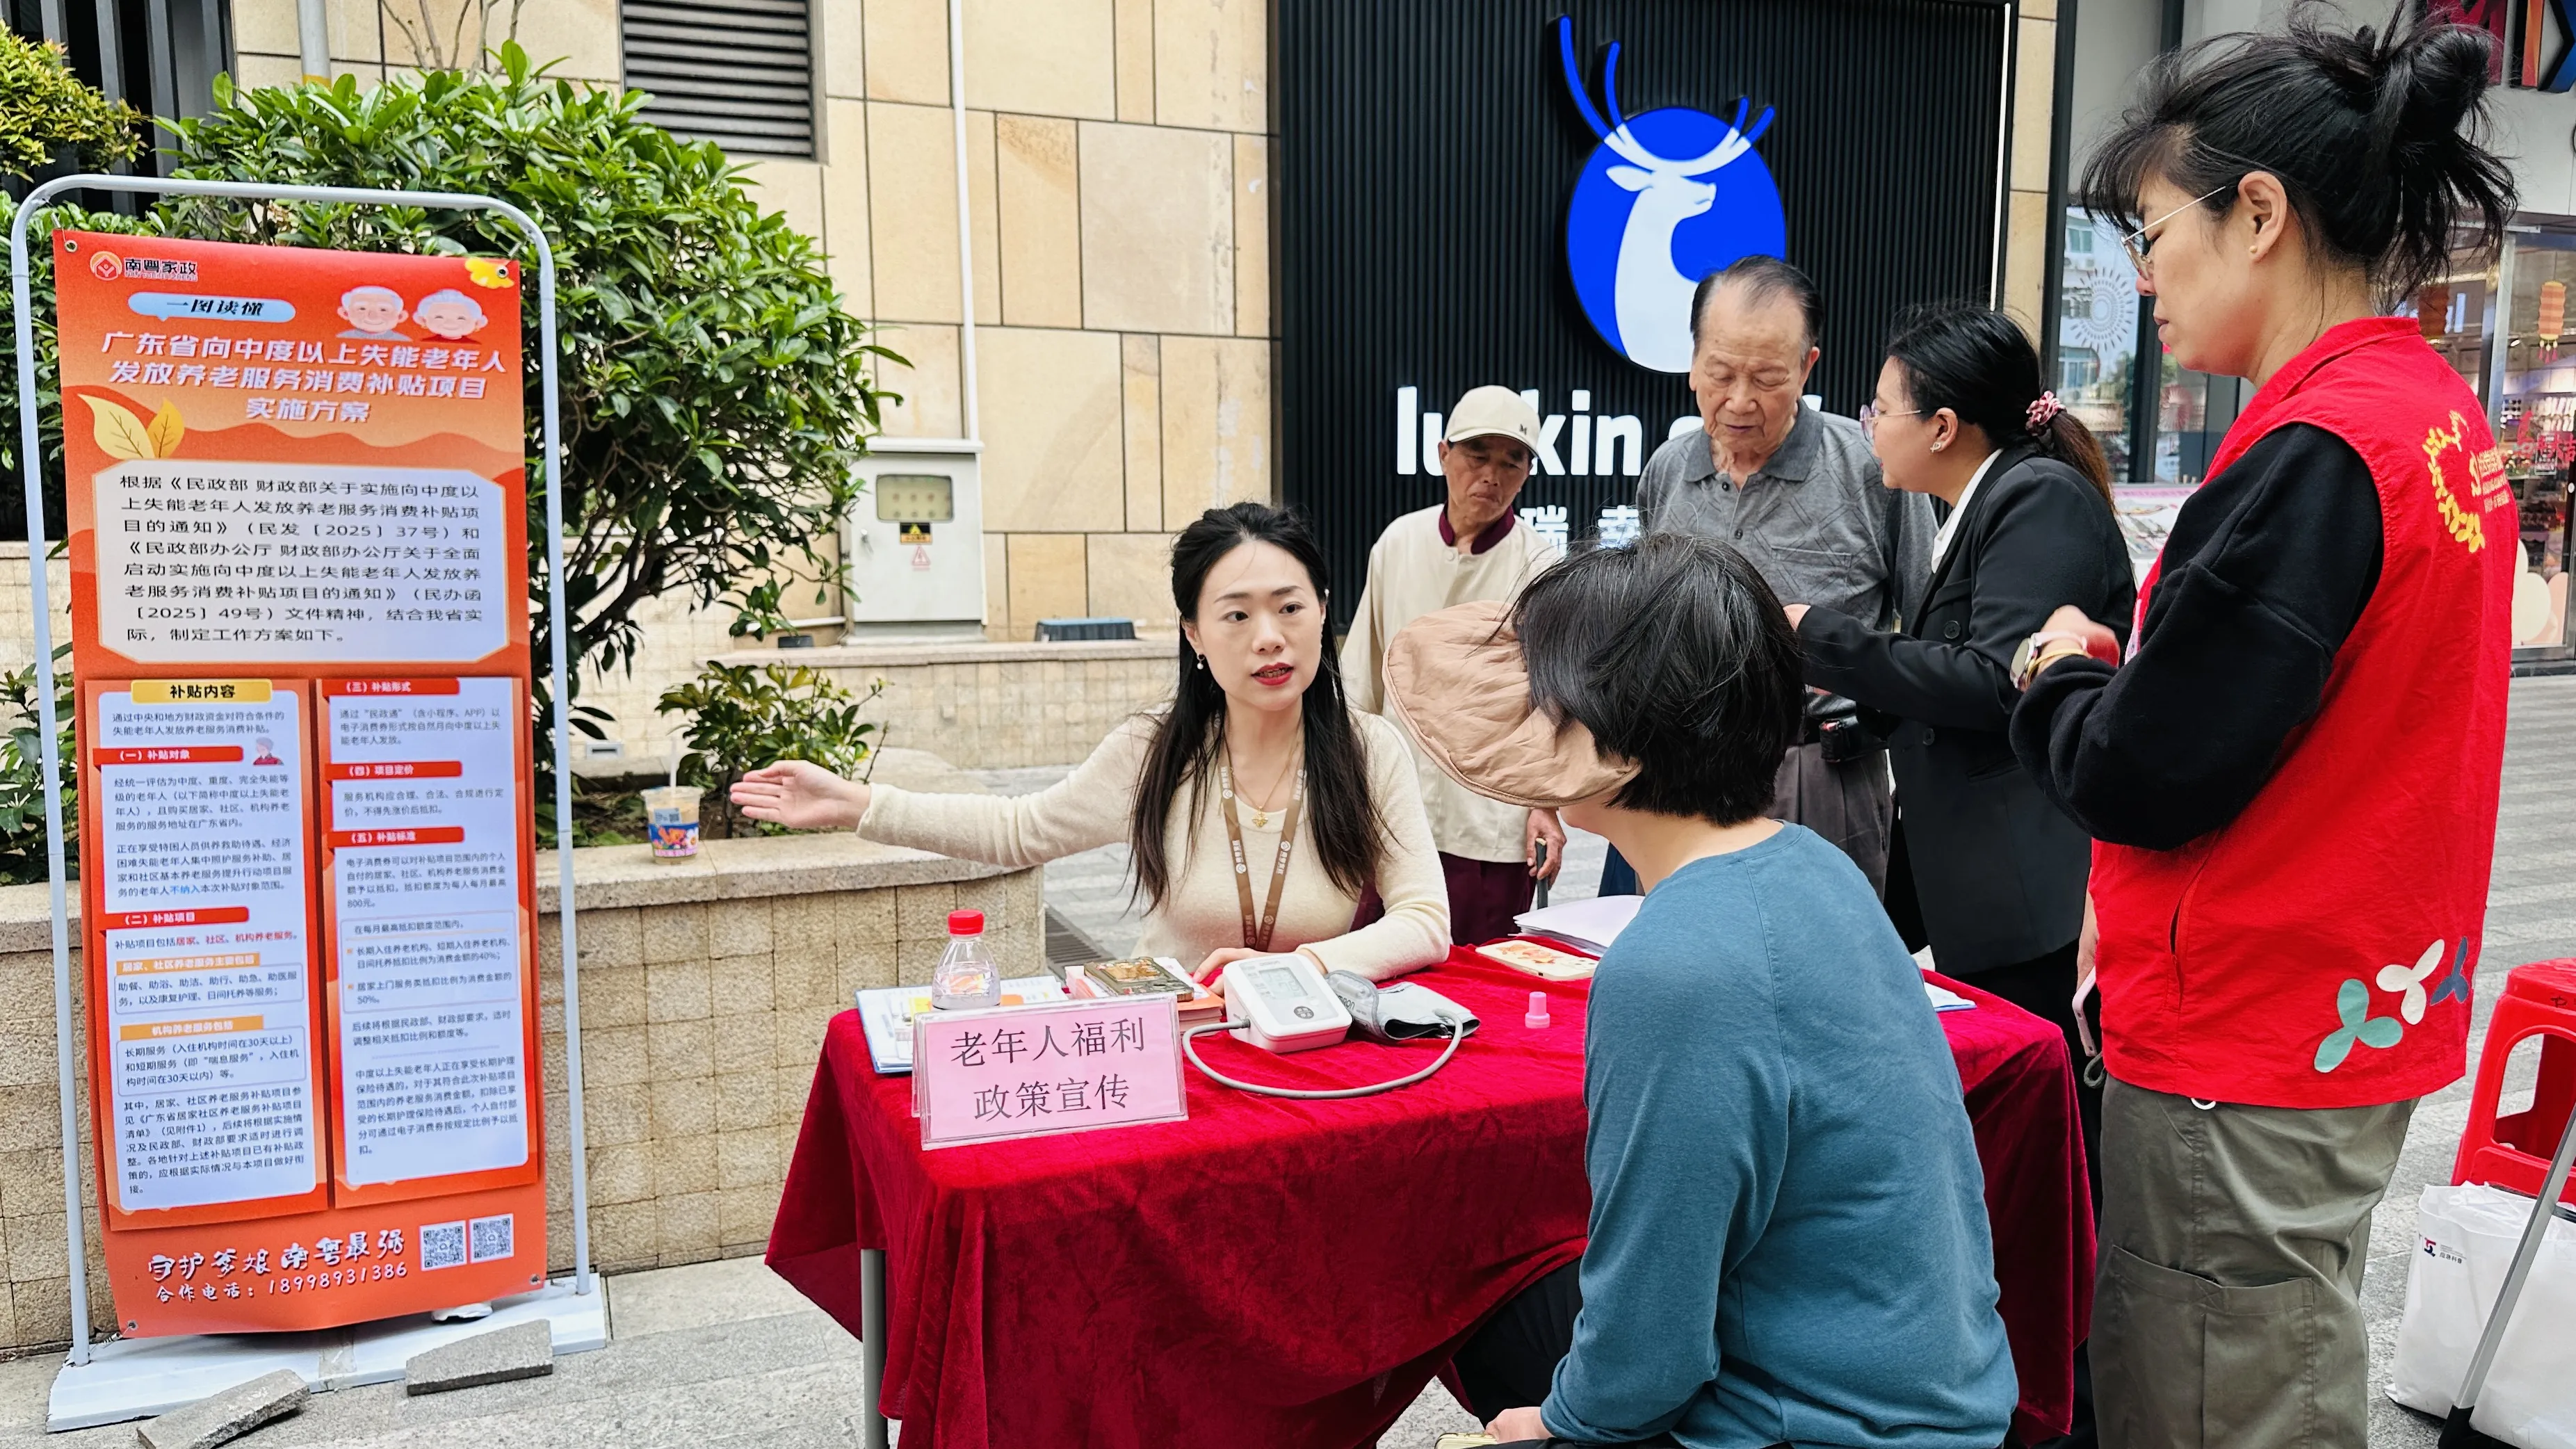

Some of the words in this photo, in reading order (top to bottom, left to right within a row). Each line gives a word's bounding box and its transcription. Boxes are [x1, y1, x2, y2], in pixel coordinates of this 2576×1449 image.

[167, 299, 264, 316] 一图读懂
[102, 331, 508, 374] 广东省向中度以上失能老年人
[108, 360, 487, 400] 发放养老服务消费补贴项目
[246, 396, 371, 423] 实施方案
[1398, 386, 1643, 476] lukin
[120, 475, 249, 492] 根据《民政部
[255, 479, 480, 499] 财政部关于实施向中度以
[121, 497, 480, 520] 上失能老年人发放养老服务消费补贴项
[280, 544, 480, 561] 财政部办公厅关于全面
[124, 562, 482, 582] 启动实施向中度以上失能老年人发放养
[170, 684, 236, 699] 补贴内容
[112, 711, 284, 722] 通过中央和地方财政资金对符合条件的
[113, 724, 270, 736] 失能老年人发放养老服务消费补贴。
[116, 818, 243, 832] 服务的服务地址在广东省内。
[950, 1017, 1144, 1067] 老年人福利
[973, 1074, 1130, 1122] 政策宣传
